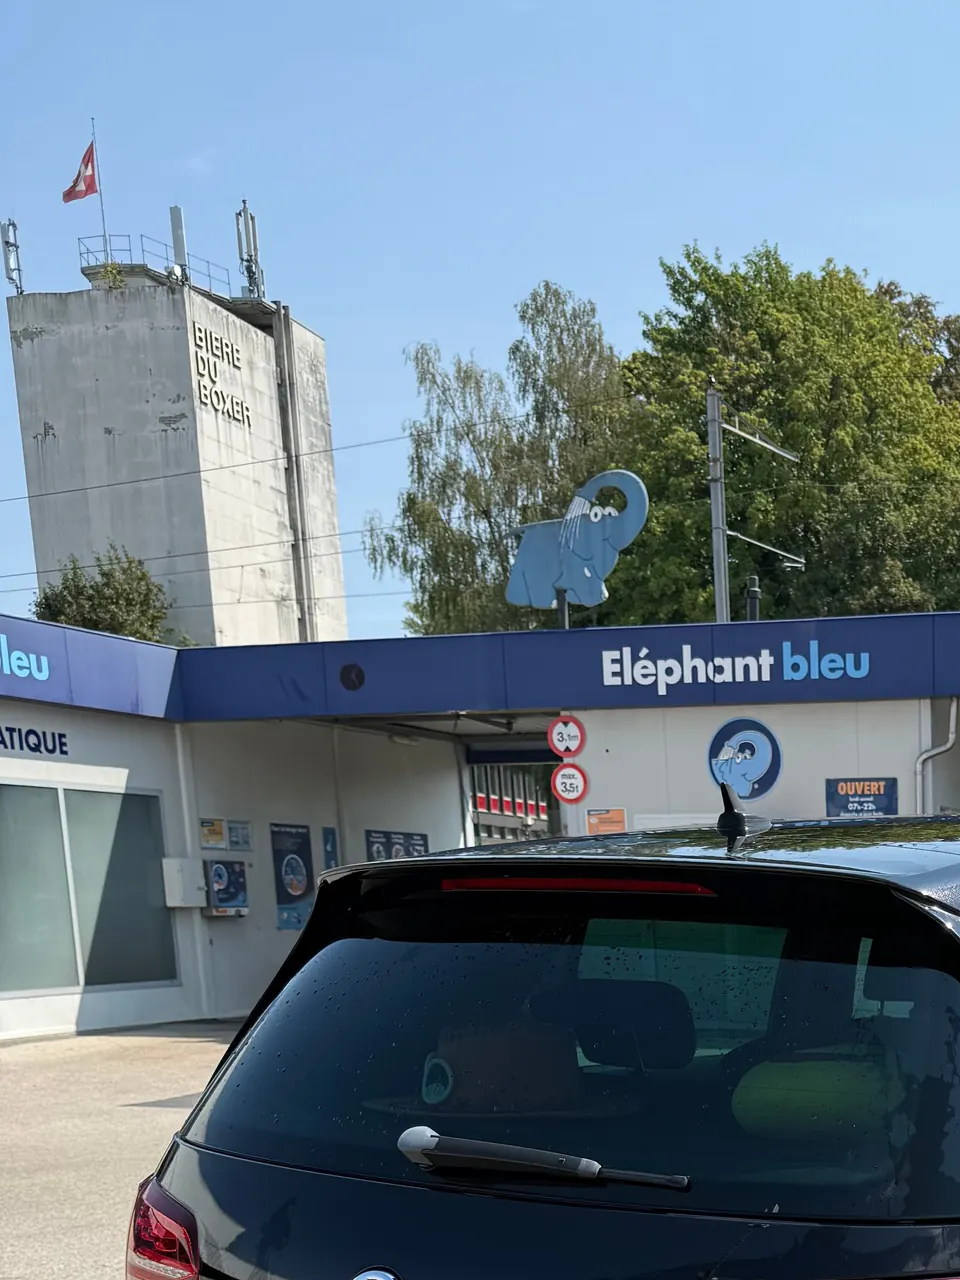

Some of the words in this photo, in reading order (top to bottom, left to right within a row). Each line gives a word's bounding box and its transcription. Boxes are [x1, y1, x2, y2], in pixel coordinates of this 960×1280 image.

[193, 321, 242, 369] BIERE
[196, 351, 218, 385] DU
[198, 380, 252, 427] BOXER
[0, 633, 49, 681] leu
[602, 645, 774, 695] Eléphant
[782, 640, 870, 681] bleu
[837, 781, 886, 795] OUVERT
